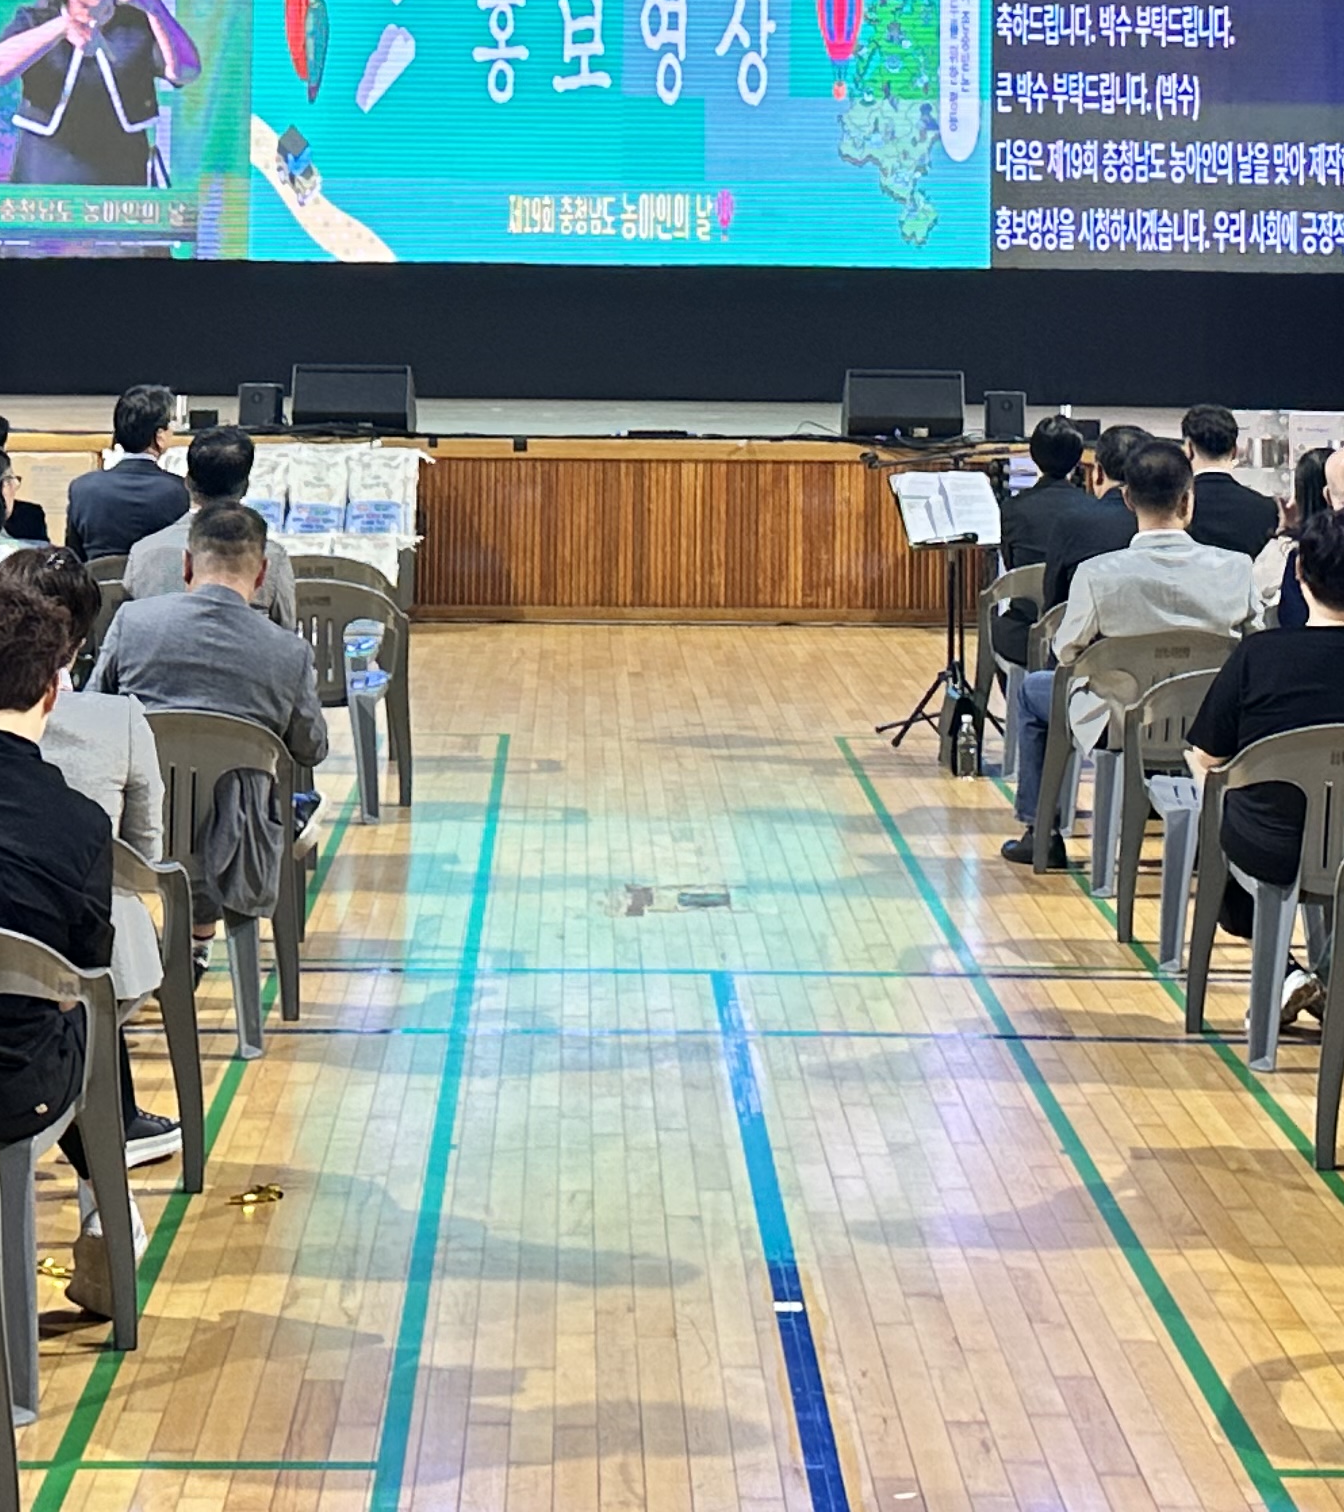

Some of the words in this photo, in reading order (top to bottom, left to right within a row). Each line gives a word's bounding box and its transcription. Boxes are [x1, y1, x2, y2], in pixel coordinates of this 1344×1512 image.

[995, 3, 1096, 47] 축하드립니다.
[1099, 3, 1132, 48] 박수
[1134, 4, 1236, 49] 부탁드립니다.
[995, 71, 1013, 113] 큰
[1016, 71, 1049, 114] 박수
[1051, 71, 1152, 115] 부탁드립니다.
[1155, 72, 1201, 121] (박수)
[995, 139, 1044, 181] 다음은
[1047, 139, 1098, 183] 제19회
[1102, 140, 1166, 184] 충청남도
[1169, 141, 1233, 185] 농아인의
[1236, 141, 1270, 185] 날을
[1272, 142, 1306, 186] 맞아
[507, 194, 555, 234] 제19회
[559, 195, 616, 235] 충청남도
[620, 192, 690, 240] 농아인의
[695, 193, 714, 242] 날
[995, 206, 1076, 251] 홍보영상을
[1078, 207, 1211, 254] 시청하시겠습니다.
[1213, 210, 1248, 255] 우리
[1249, 210, 1298, 255] 사회에
